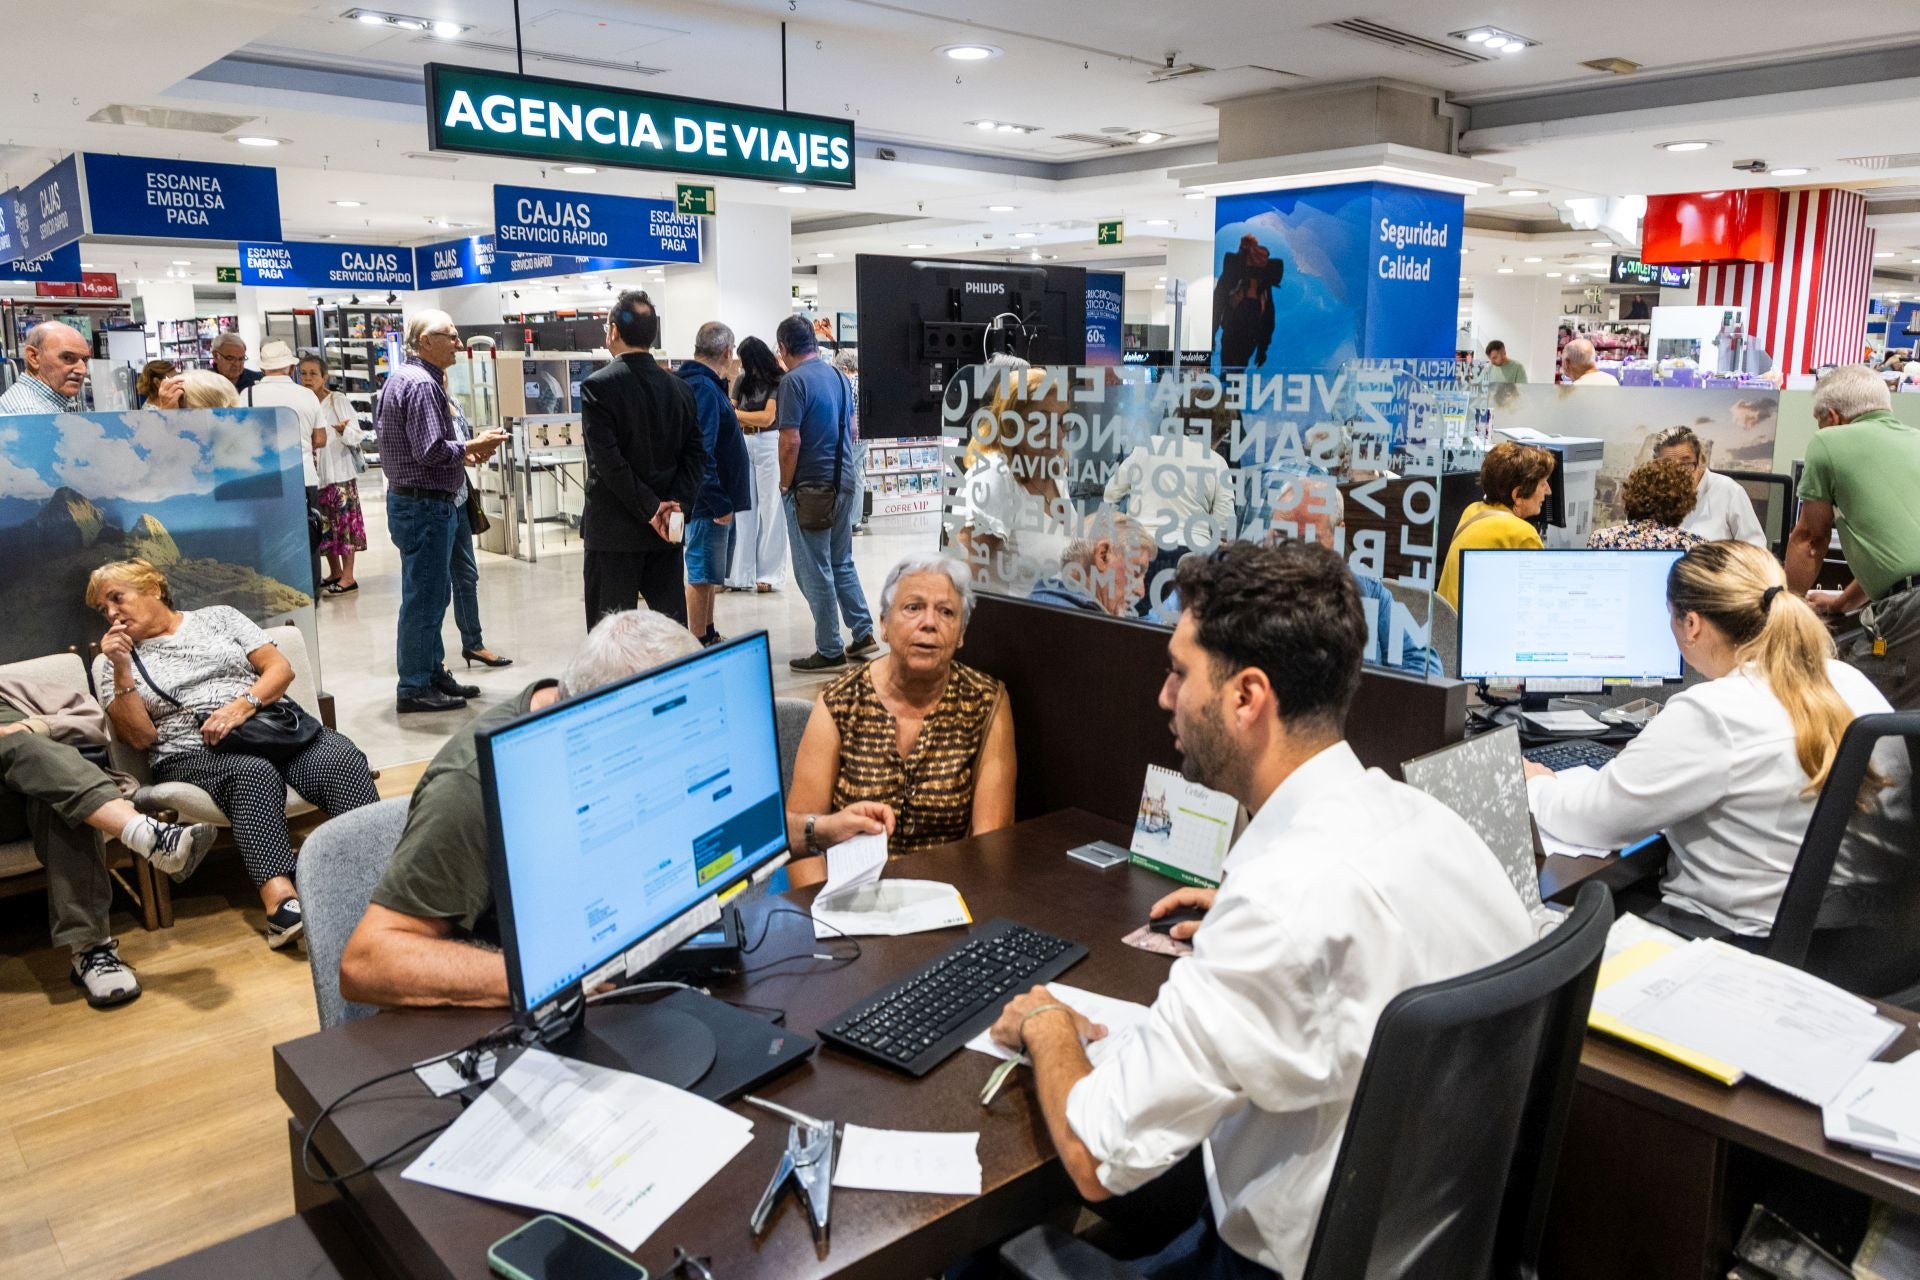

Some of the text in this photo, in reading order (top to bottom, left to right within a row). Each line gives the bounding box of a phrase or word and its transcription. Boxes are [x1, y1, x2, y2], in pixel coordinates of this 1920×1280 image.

[444, 89, 850, 174] AGENCIA DE VIAJES
[146, 172, 222, 193] ESCANEA
[40, 181, 61, 219] CAJAS
[146, 190, 225, 210] EMBOLSA
[166, 208, 210, 226] PAGA
[516, 198, 591, 229] CAJAS
[650, 209, 696, 226] ESCANEA
[500, 224, 608, 247] SERVICIO RÁPIDO
[650, 223, 697, 239] EMBOLSA
[1379, 217, 1448, 250] Seguridad
[660, 238, 687, 252] PAGA
[247, 247, 291, 260] ESCANEA
[340, 251, 398, 272] CAJAS
[434, 248, 458, 269] CAJAS
[12, 261, 43, 273] PAGA
[247, 257, 293, 270] EMBOLSA
[510, 258, 533, 272] SERVICIO
[1378, 254, 1431, 281] Calidad
[258, 268, 284, 279] PAGA
[329, 268, 412, 283] SERVICIO RÁPIDO
[965, 281, 1005, 295] PHILIPS
[1085, 300, 1105, 309] STICO
[1087, 329, 1106, 344] 60%
[884, 500, 929, 514] COFRE VIP
